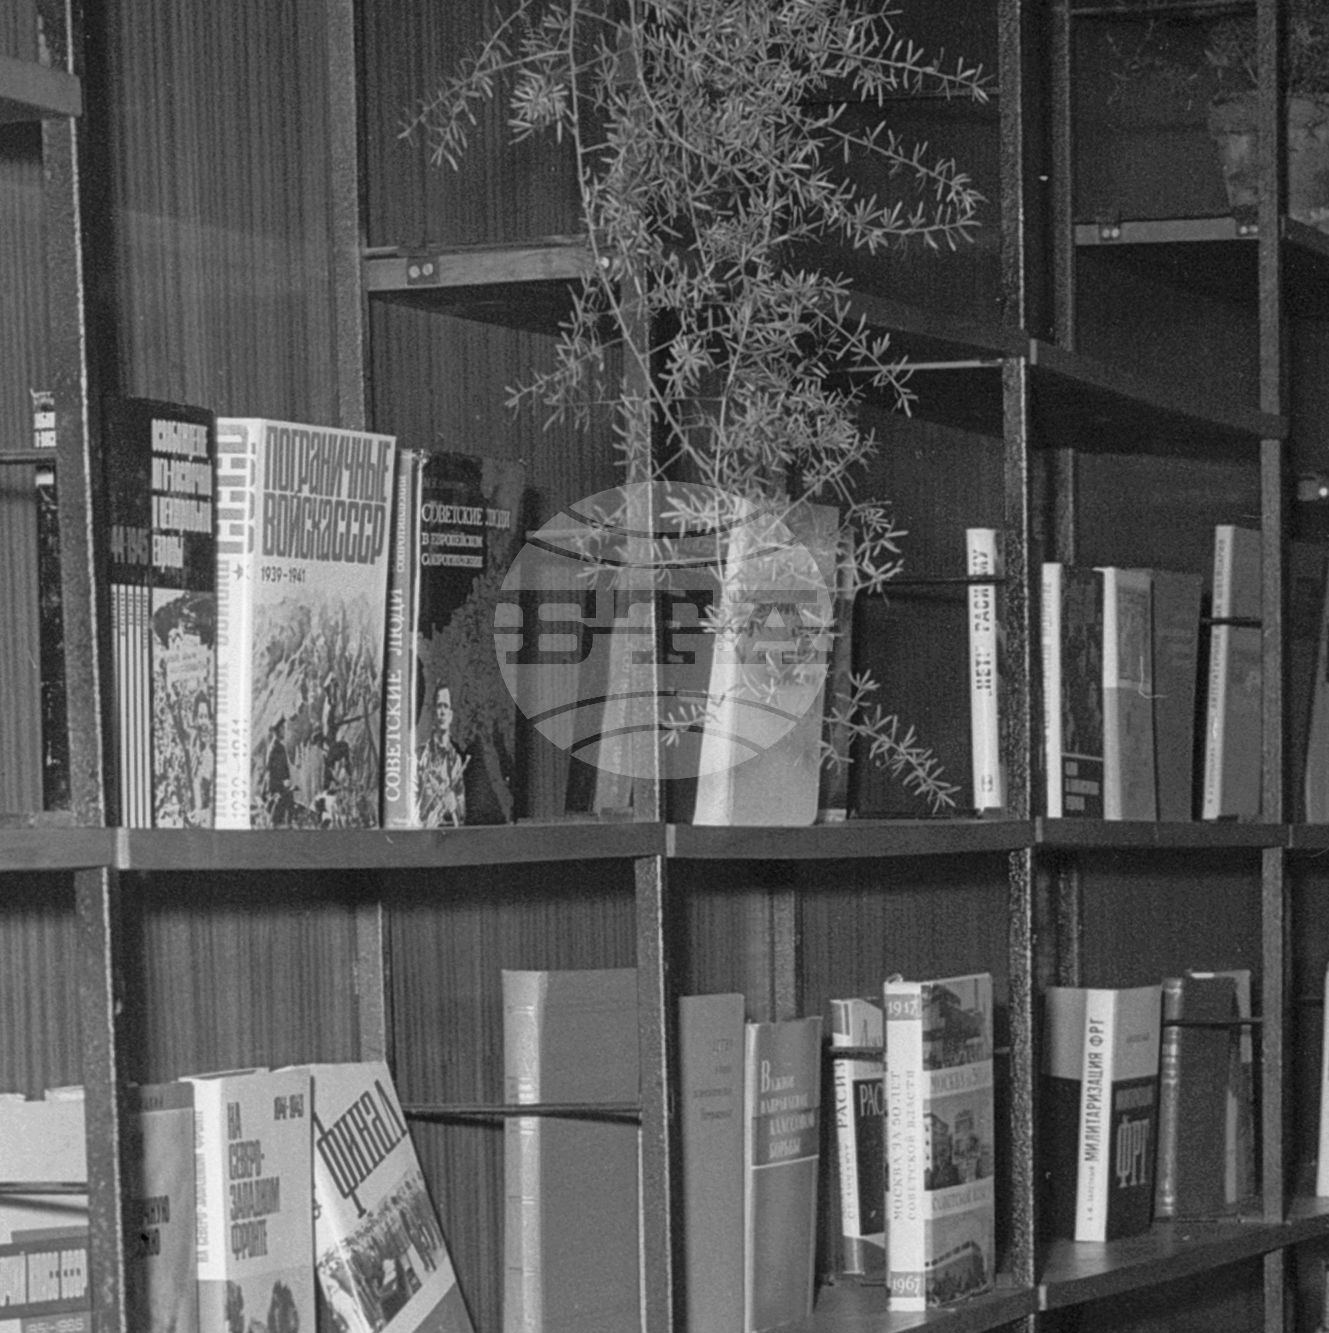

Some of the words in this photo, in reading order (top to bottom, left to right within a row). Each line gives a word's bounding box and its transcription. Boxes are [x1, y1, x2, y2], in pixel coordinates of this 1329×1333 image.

[264, 425, 391, 503] ПОГРАНИЧНЫЕ
[262, 491, 332, 562] ВОЙСКА
[331, 499, 386, 565] СССР
[422, 502, 483, 528] СОВЕТСКИЕ
[261, 566, 306, 583] 1939-1941
[972, 548, 991, 634] РАСИМУ
[392, 588, 404, 657] ЛЮДИ
[385, 669, 403, 802] СОВЕТСКИЕ
[1089, 1018, 1105, 1047] ФРГ
[1084, 1052, 1104, 1162] МИЛИТАРИЗАЦИЯ
[313, 1080, 408, 1219] ФИНАЛ
[892, 1156, 904, 1221] МОСКВА
[891, 1277, 922, 1294] 1967
